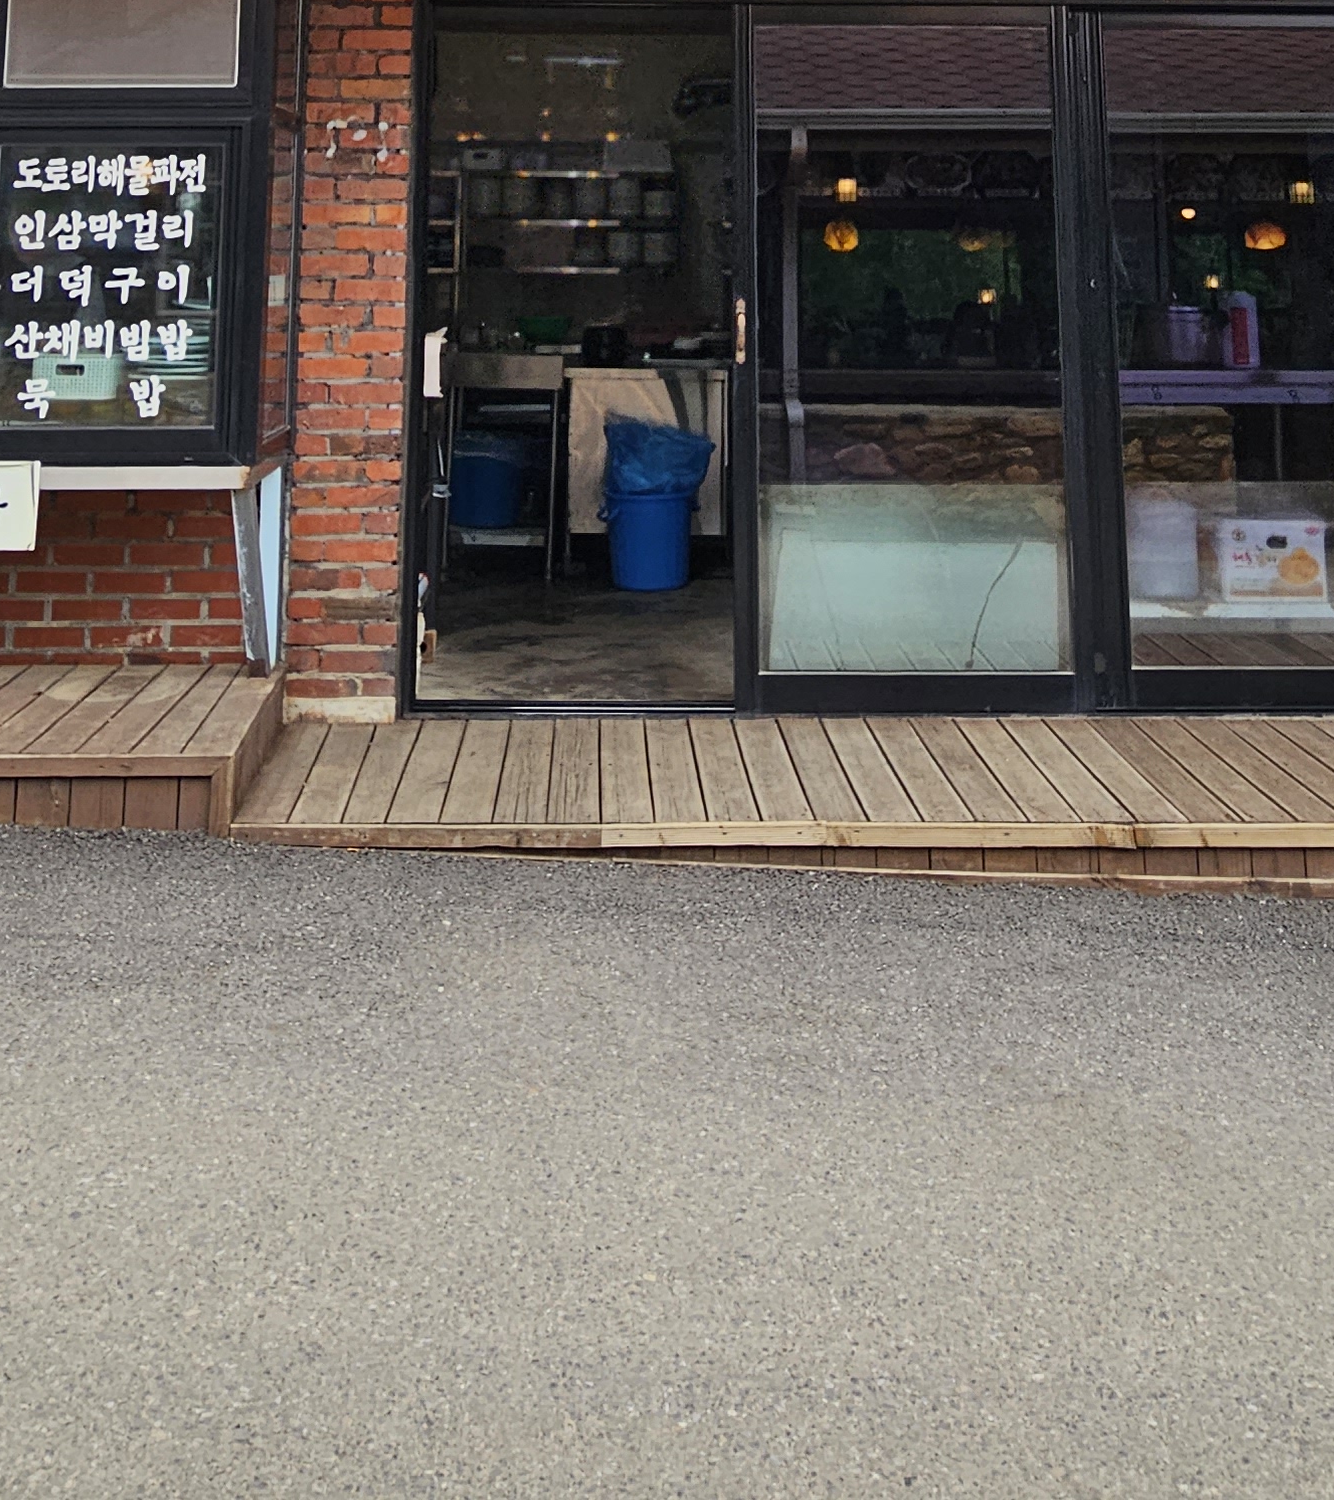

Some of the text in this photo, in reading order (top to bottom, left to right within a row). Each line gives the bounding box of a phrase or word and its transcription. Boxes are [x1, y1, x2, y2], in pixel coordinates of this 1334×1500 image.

[13, 153, 206, 196] 도토리해물파전
[15, 209, 194, 250] 인삼막걸리
[10, 264, 190, 307] 더덕구이
[4, 319, 193, 362] 산채비빔밥
